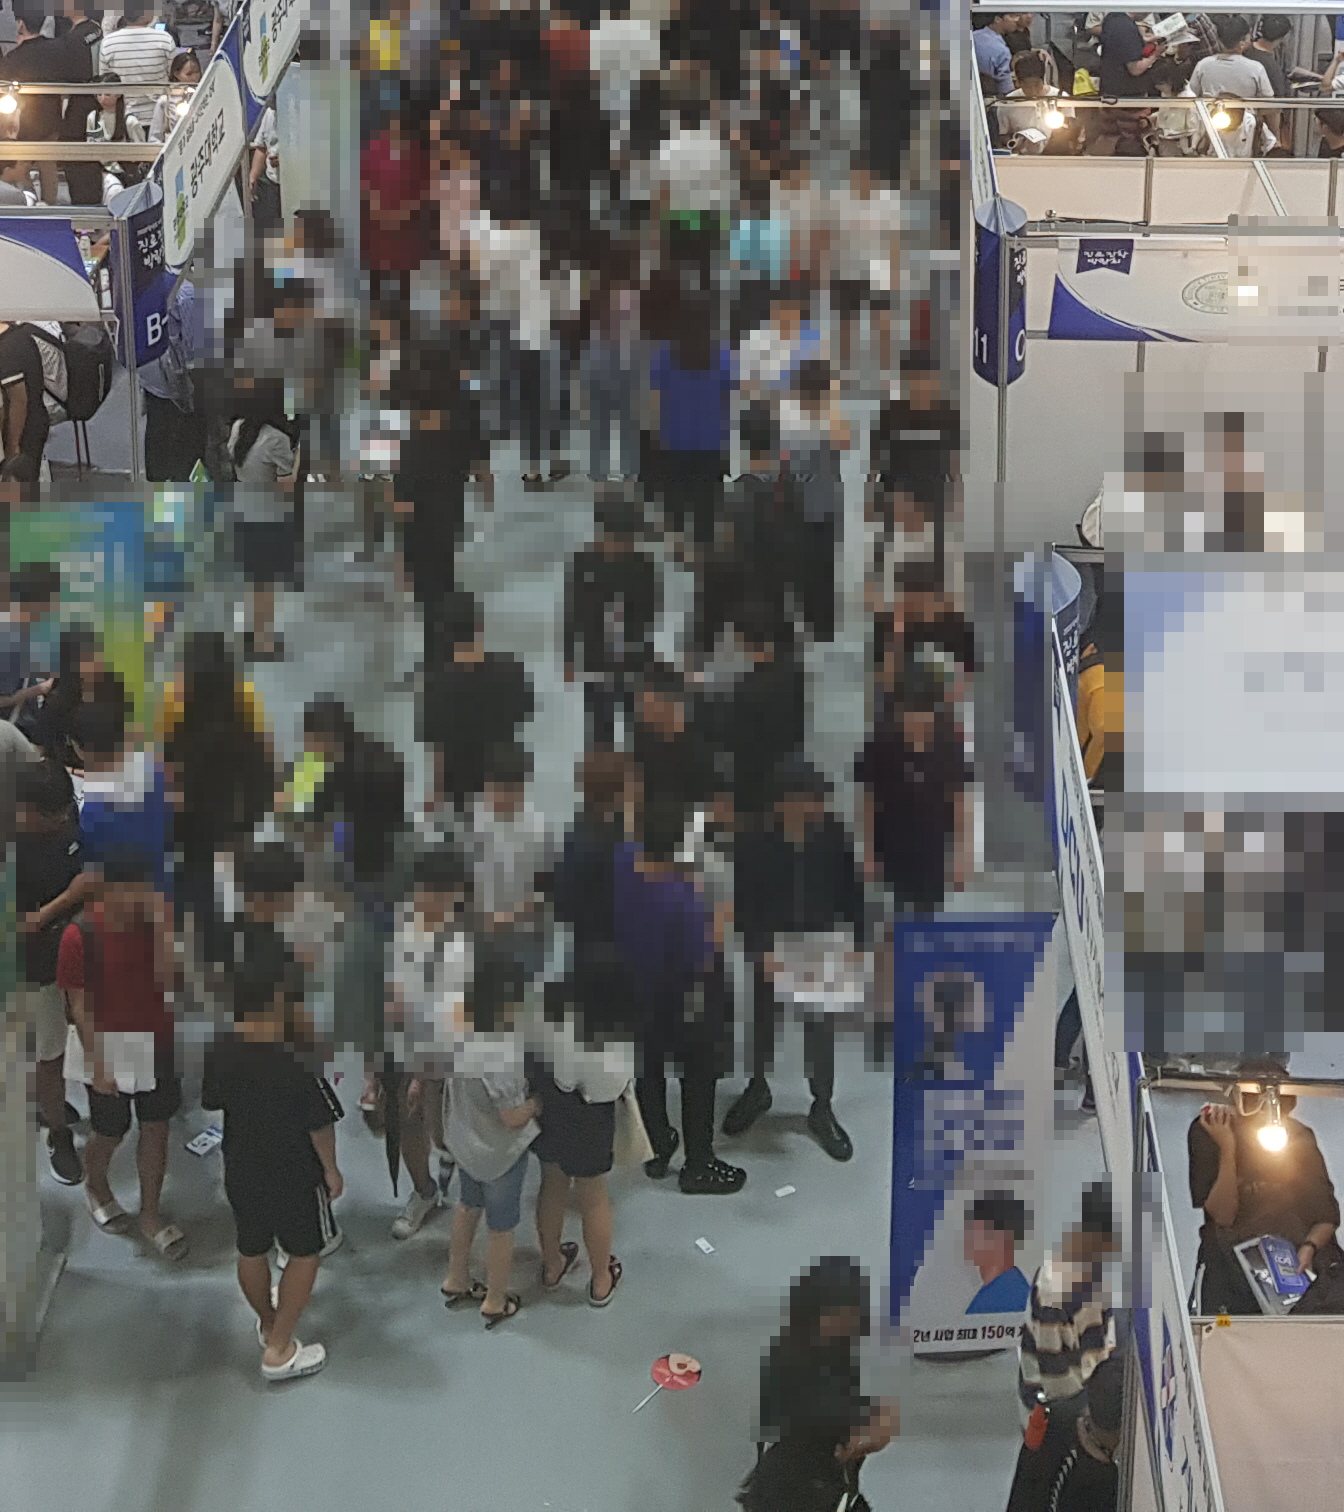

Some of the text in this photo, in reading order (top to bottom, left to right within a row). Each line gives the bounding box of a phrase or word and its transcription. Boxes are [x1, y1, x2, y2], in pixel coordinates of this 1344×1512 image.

[189, 107, 226, 200] 광주대학교
[932, 1327, 955, 1342] 사업
[955, 1326, 979, 1342] 최대
[980, 1323, 1016, 1341] 150억
